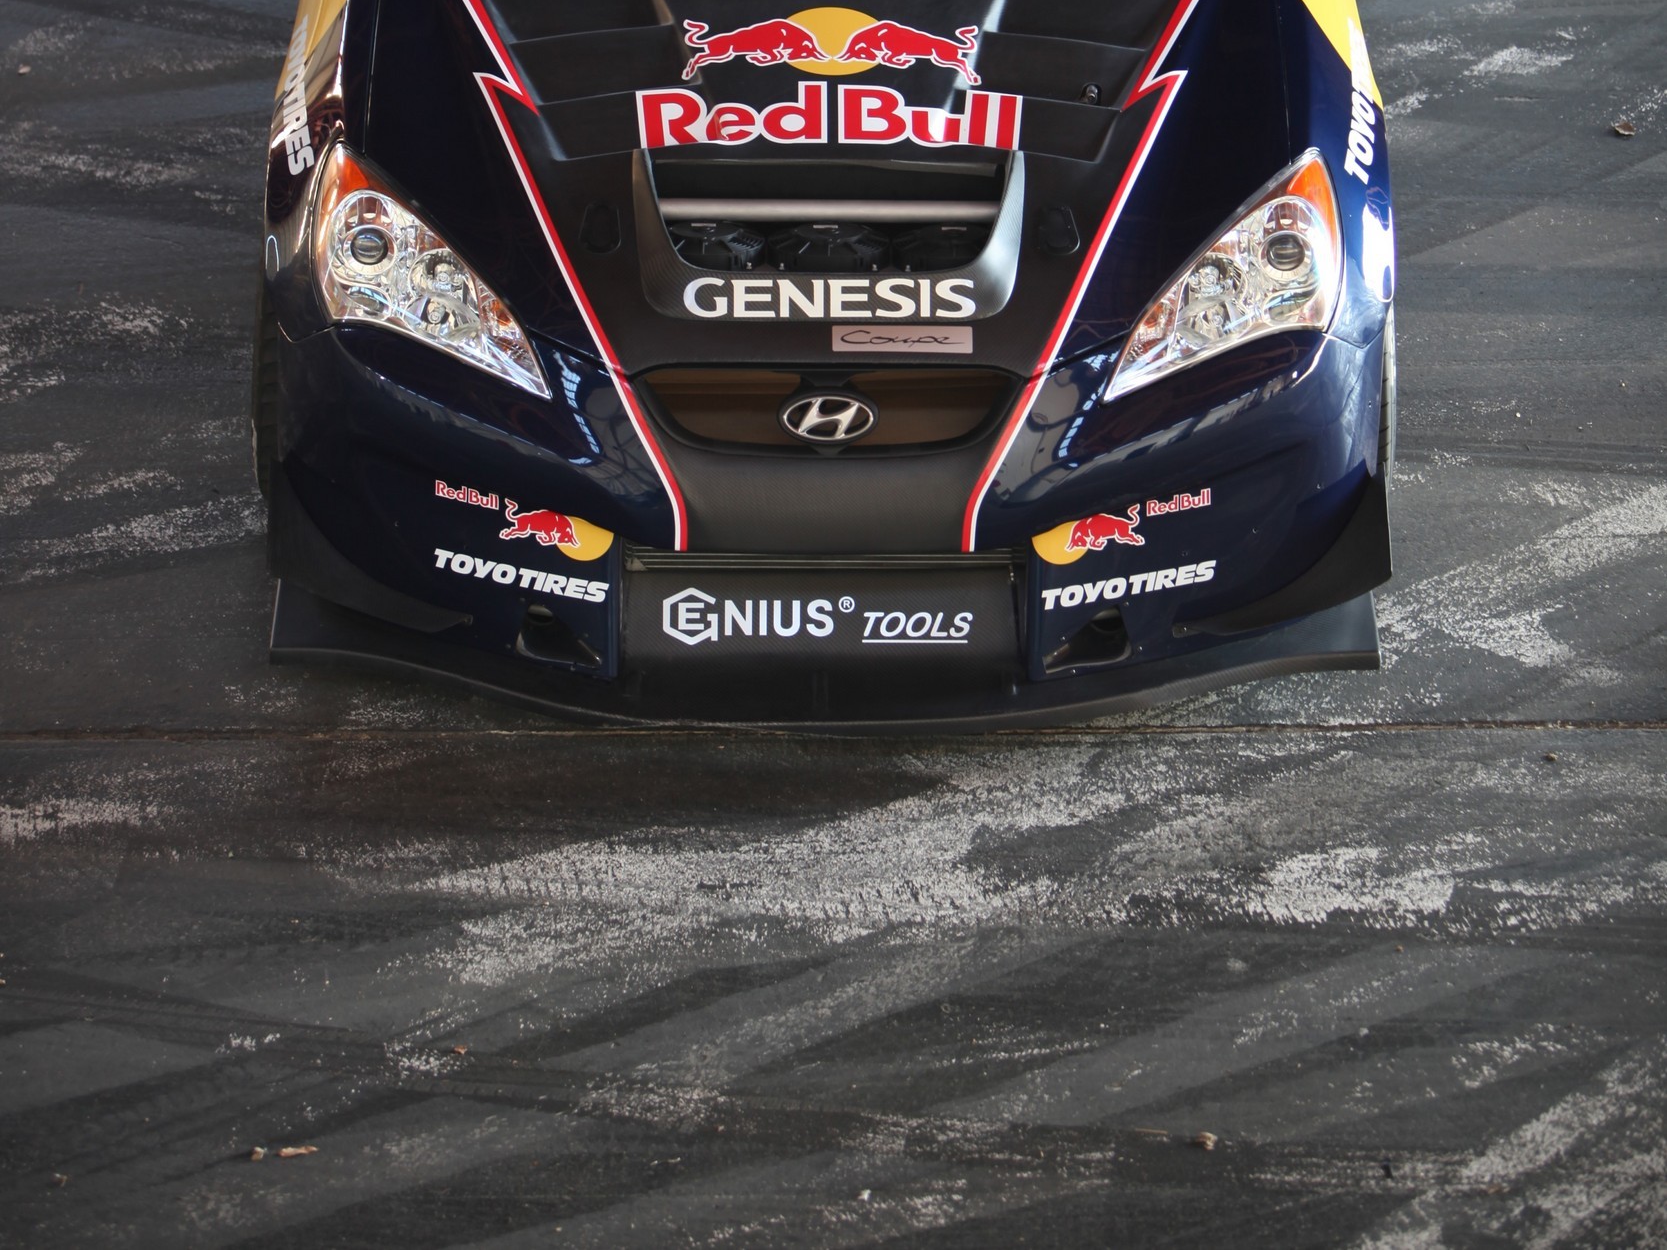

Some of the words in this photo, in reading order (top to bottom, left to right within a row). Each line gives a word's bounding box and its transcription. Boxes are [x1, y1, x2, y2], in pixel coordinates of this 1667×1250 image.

[282, 82, 315, 176] TIRES
[636, 81, 828, 148] Red
[838, 84, 1023, 150] Bull
[1343, 91, 1376, 185] TOYO
[683, 277, 976, 318] GENESIS
[435, 480, 468, 503] Red
[468, 488, 499, 510] Bull
[1146, 497, 1180, 516] Red
[1180, 488, 1211, 510] Bull
[435, 548, 517, 585] TOYO
[518, 567, 609, 603] TIRES
[1042, 575, 1126, 610] TOYO
[1127, 560, 1216, 594] TIRES
[862, 611, 973, 643] TOOLS
